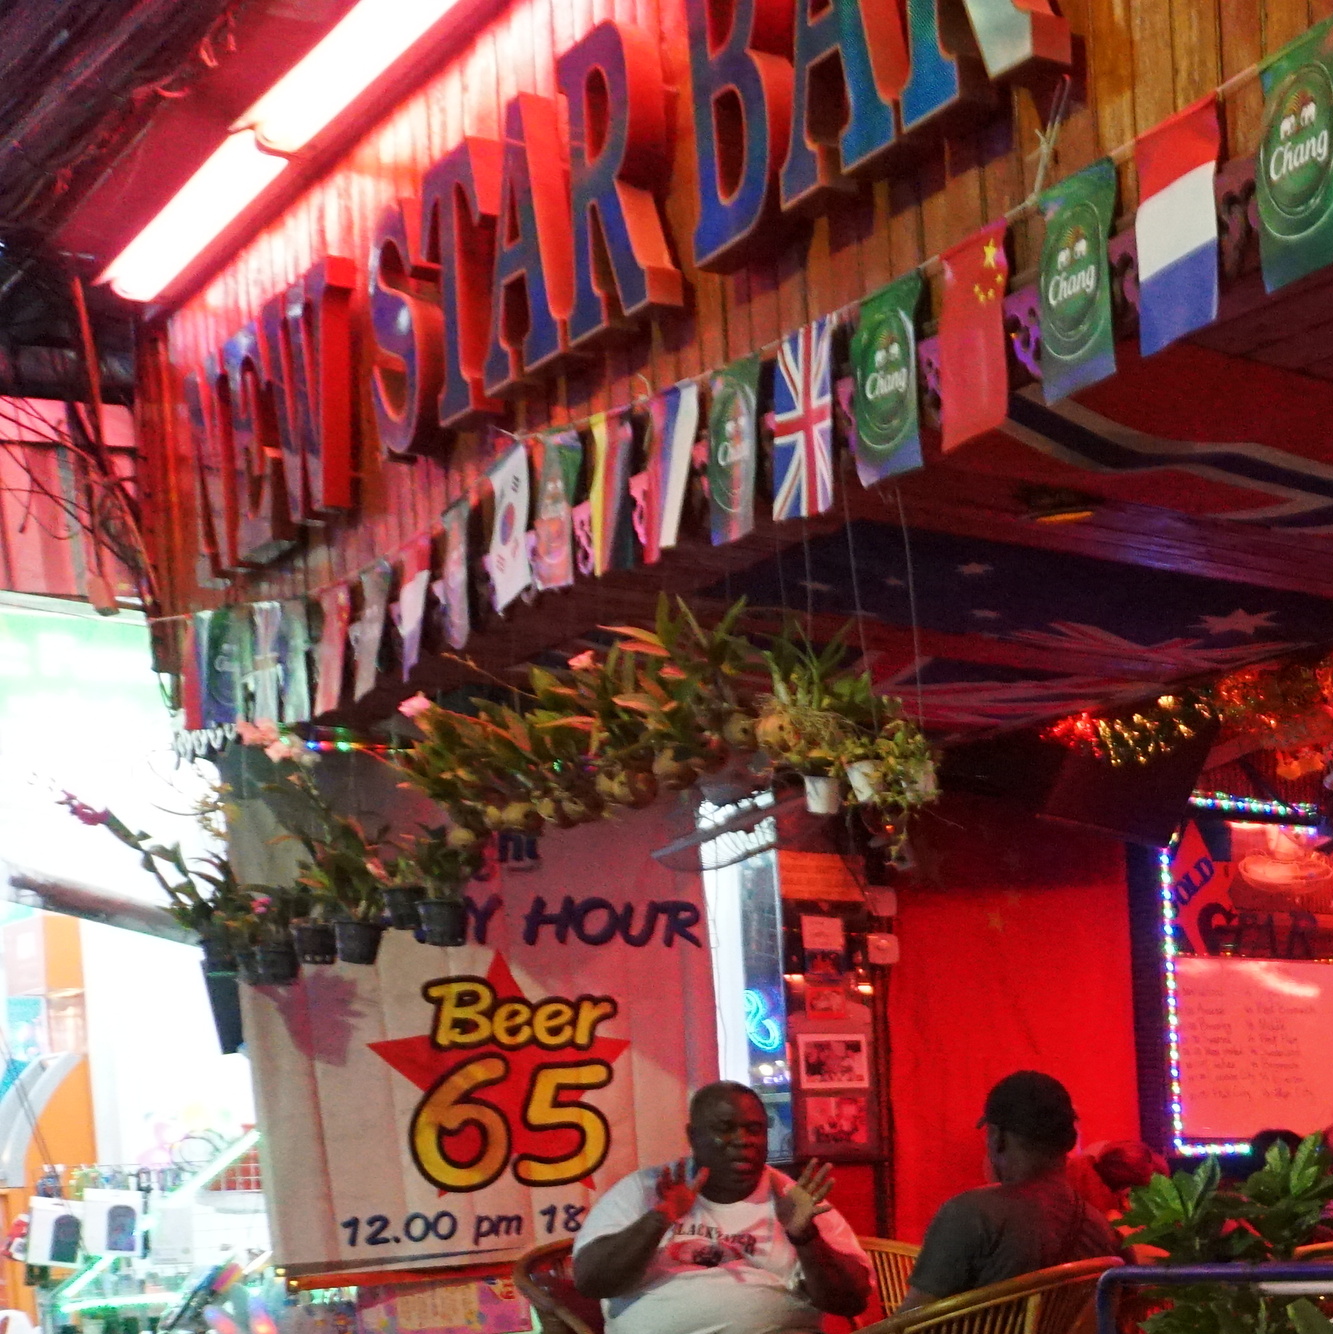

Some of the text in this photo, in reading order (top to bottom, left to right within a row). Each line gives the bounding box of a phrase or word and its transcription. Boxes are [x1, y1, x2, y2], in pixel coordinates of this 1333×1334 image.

[1270, 130, 1329, 182] Chang
[370, 20, 682, 456] STAR
[1048, 263, 1097, 307] Chang
[865, 367, 909, 400] Chang
[522, 894, 703, 949] HOUR
[423, 975, 619, 1051] Beer
[409, 1053, 614, 1194] 65
[340, 1209, 458, 1247] 12.00
[472, 1213, 522, 1246] pm
